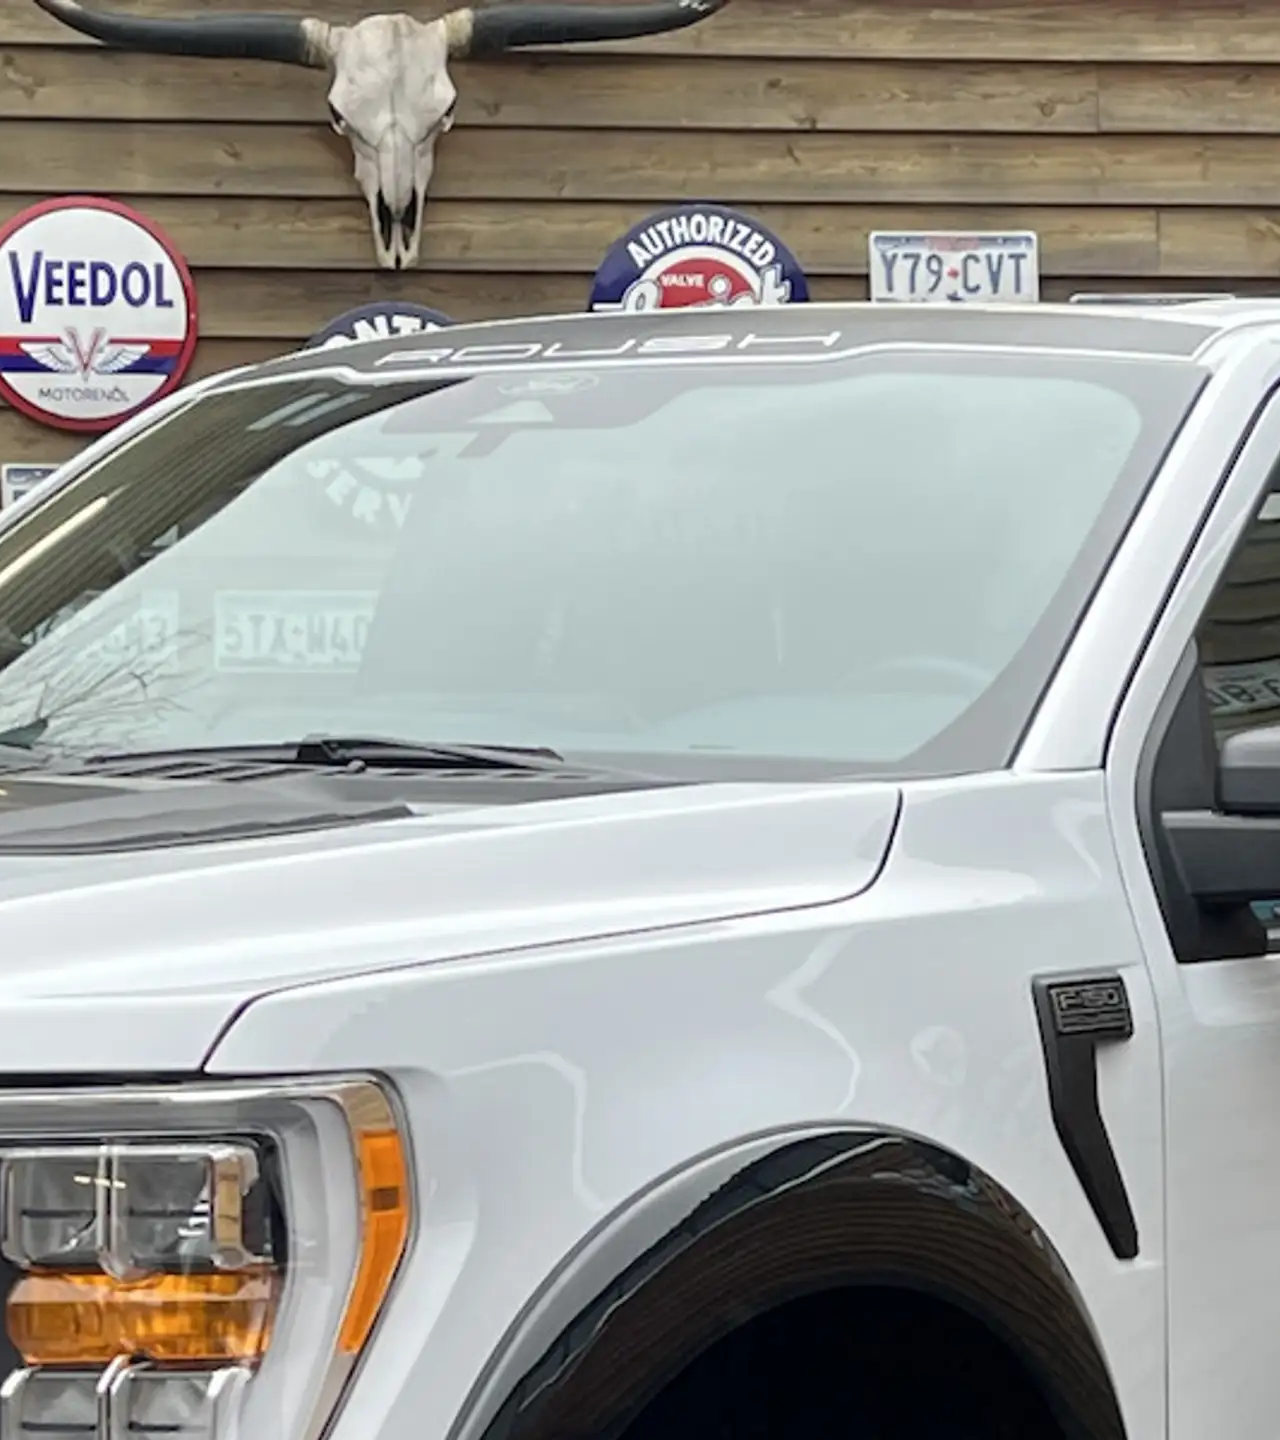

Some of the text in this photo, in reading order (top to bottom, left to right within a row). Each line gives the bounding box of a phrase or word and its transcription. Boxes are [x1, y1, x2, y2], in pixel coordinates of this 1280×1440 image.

[626, 213, 776, 268] AUTHORIZED
[8, 250, 175, 324] VEEDOL
[659, 273, 705, 288] VALVE
[880, 253, 1027, 295] Y79 CVT
[375, 331, 840, 367] ROUSH
